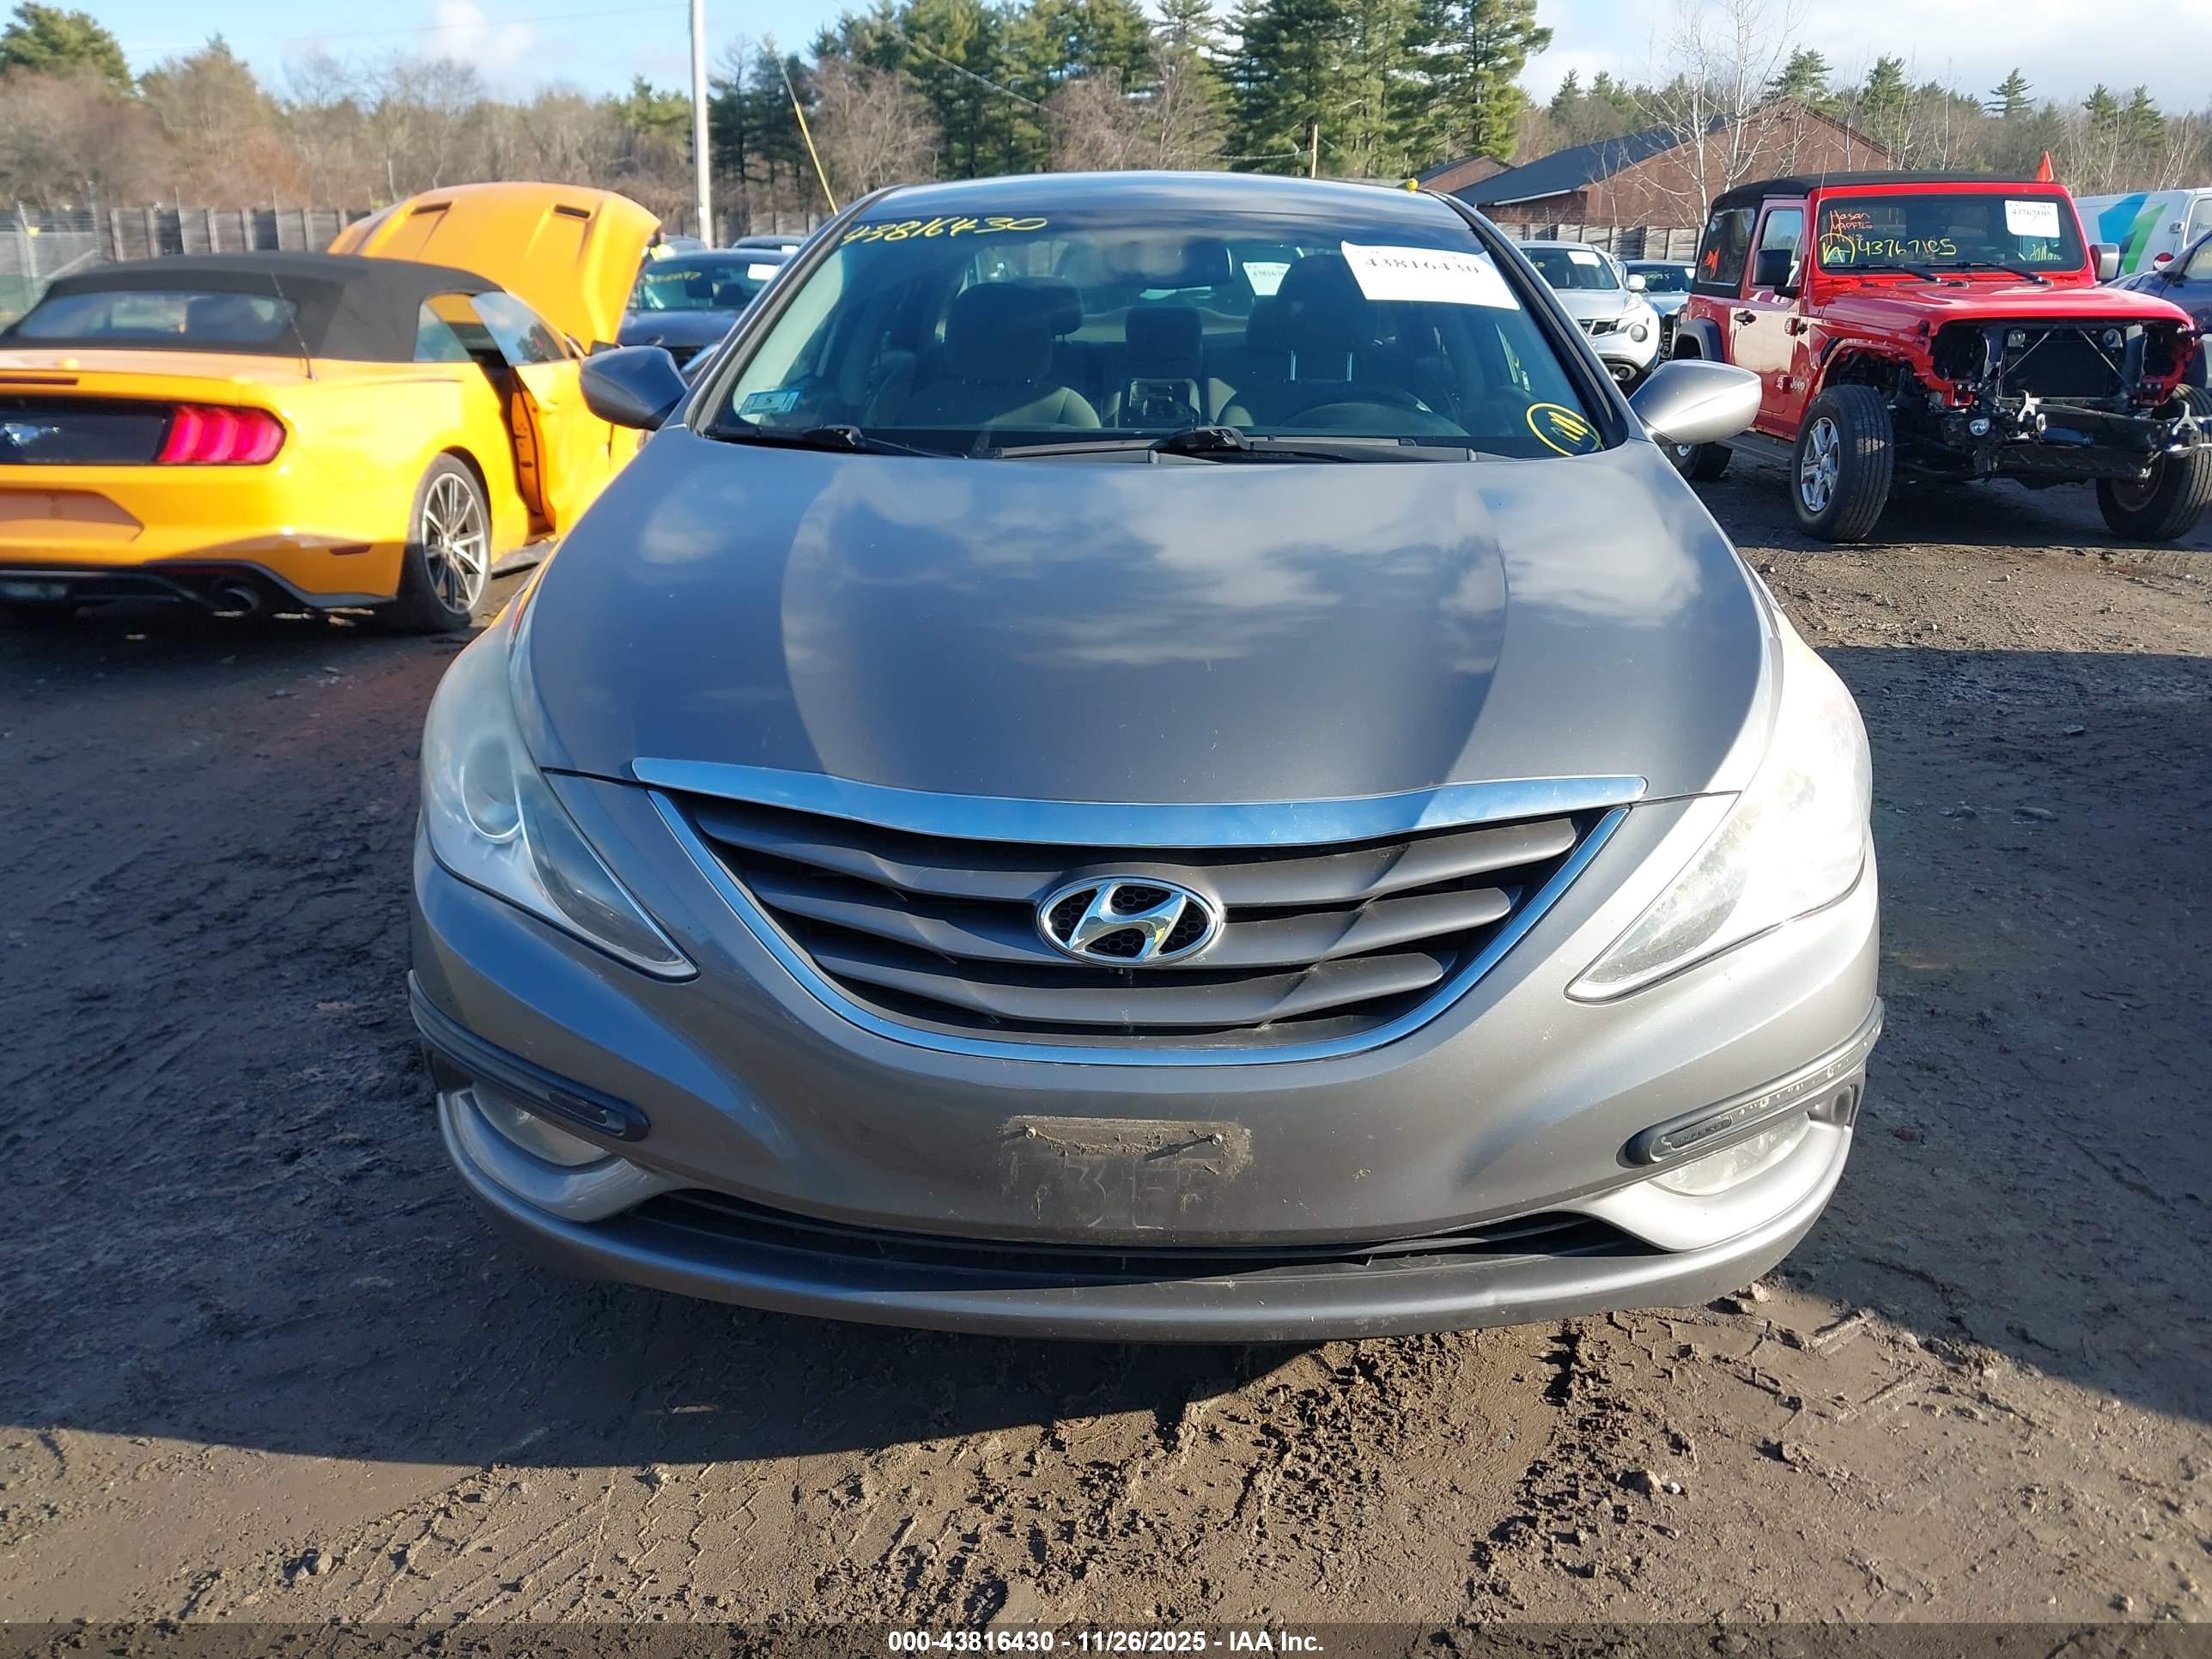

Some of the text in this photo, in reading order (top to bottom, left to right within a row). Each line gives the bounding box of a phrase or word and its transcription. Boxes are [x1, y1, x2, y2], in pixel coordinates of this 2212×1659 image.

[840, 216, 1048, 246] 43816430
[1857, 238, 1957, 258] 43767105
[1364, 257, 1480, 275] 43816430
